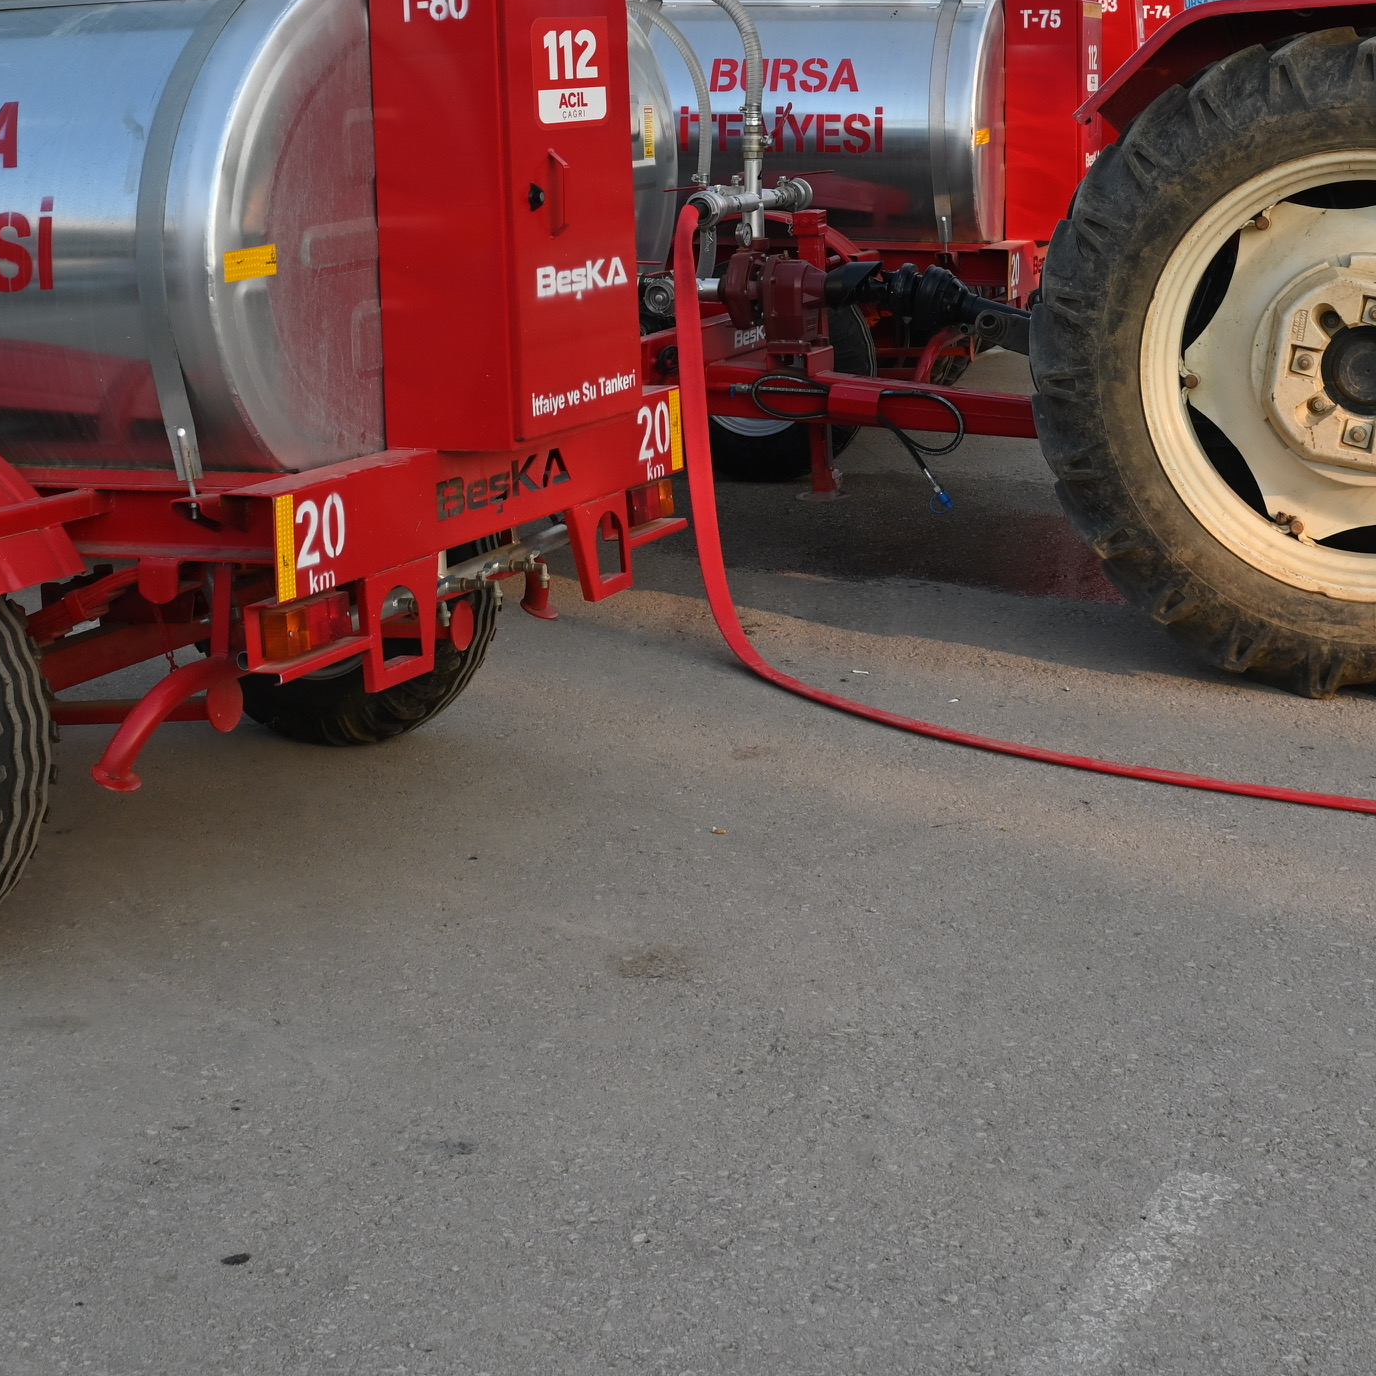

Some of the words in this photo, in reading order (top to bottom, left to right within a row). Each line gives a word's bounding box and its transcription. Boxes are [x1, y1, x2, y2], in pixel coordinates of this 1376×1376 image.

[1019, 9, 1062, 29] T-75
[1143, 5, 1171, 19] T-74
[543, 29, 599, 80] 112
[1088, 45, 1098, 70] 112
[558, 91, 588, 109] ACİL
[562, 109, 586, 121] ÇAĞRI
[532, 392, 565, 418] İtfaiye
[566, 389, 581, 407] ve
[582, 380, 597, 403] Su
[598, 369, 636, 397] Tankeri
[637, 400, 671, 462] 20
[646, 456, 665, 482] km
[295, 492, 346, 571] 20
[308, 569, 336, 595] km
